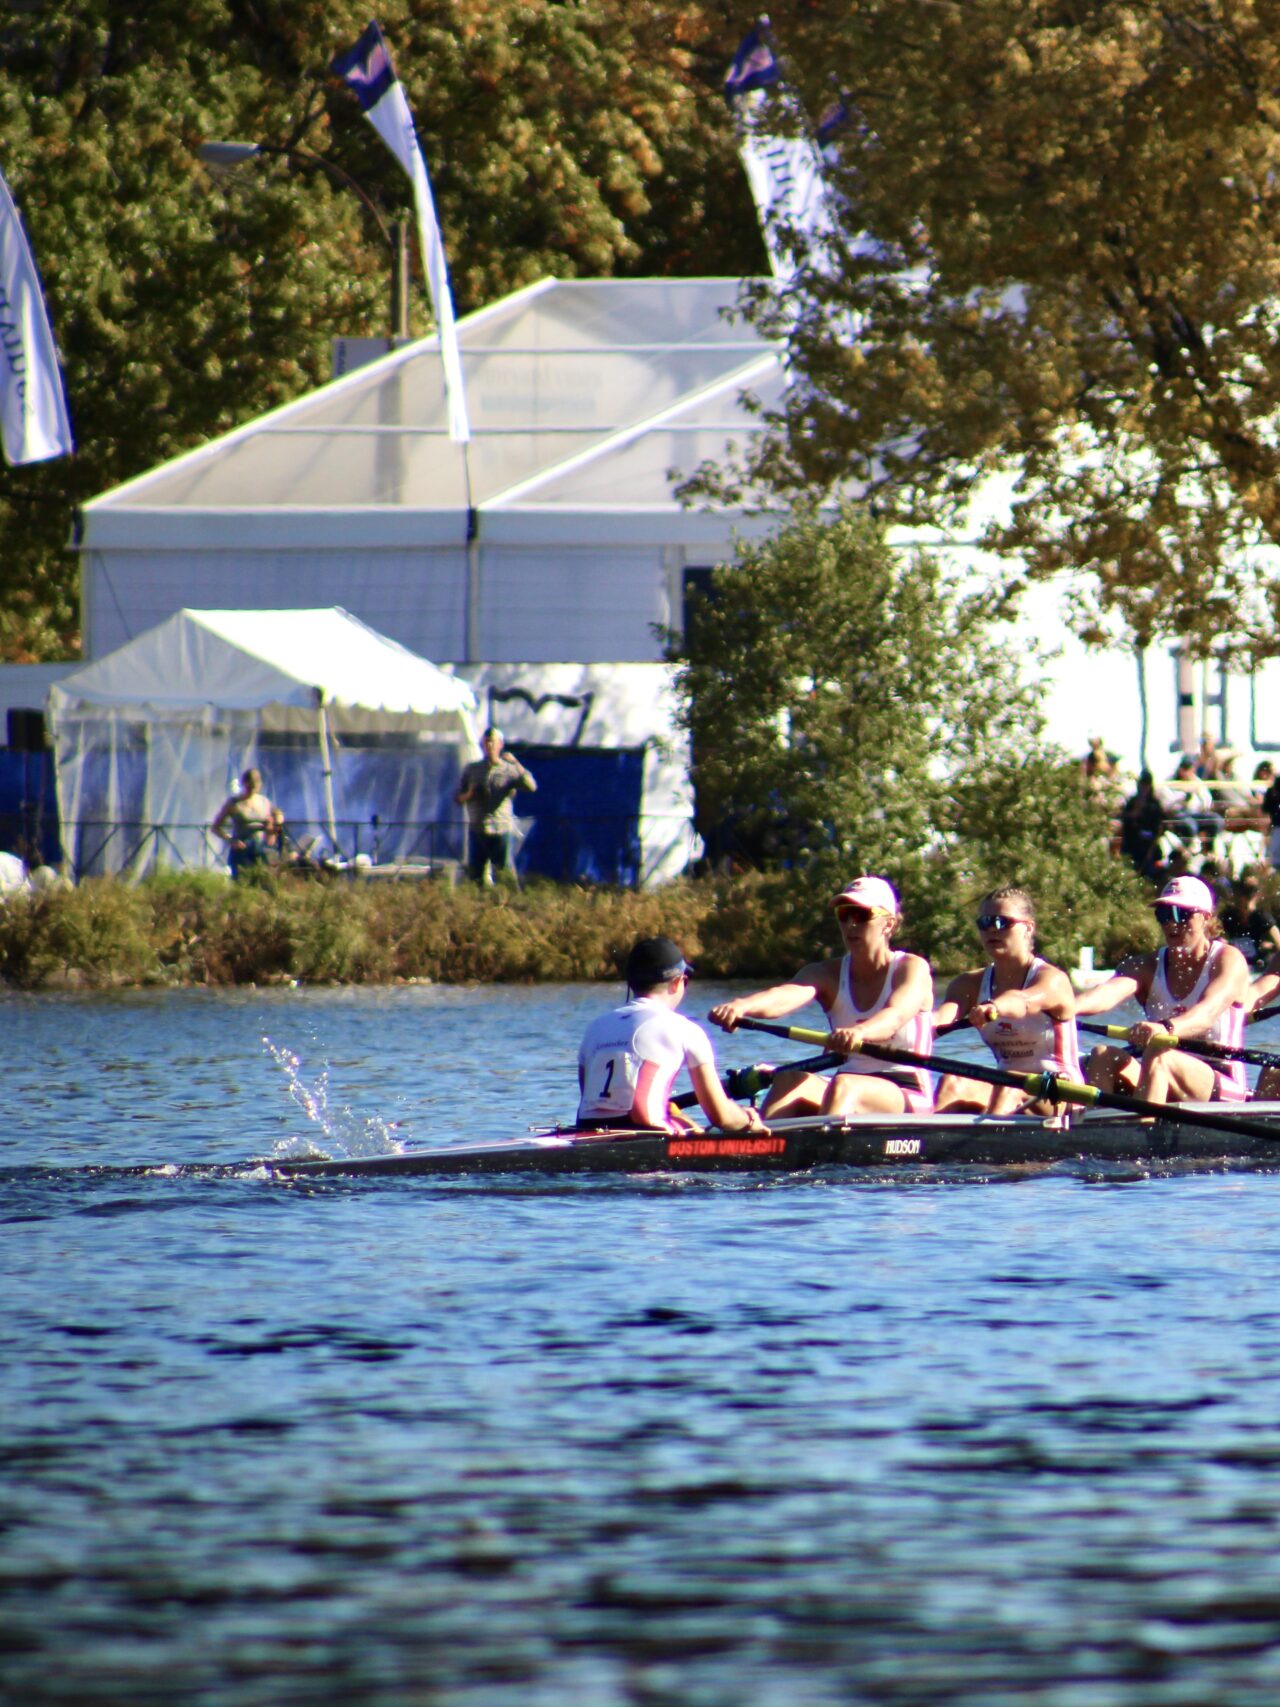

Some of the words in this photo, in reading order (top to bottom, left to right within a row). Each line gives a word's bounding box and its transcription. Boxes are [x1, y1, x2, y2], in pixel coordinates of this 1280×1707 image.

[599, 1059, 615, 1098] 1
[668, 1140, 717, 1156] BOSTON
[719, 1138, 787, 1155] UNIVERSITY
[885, 1139, 921, 1154] HUDSON
